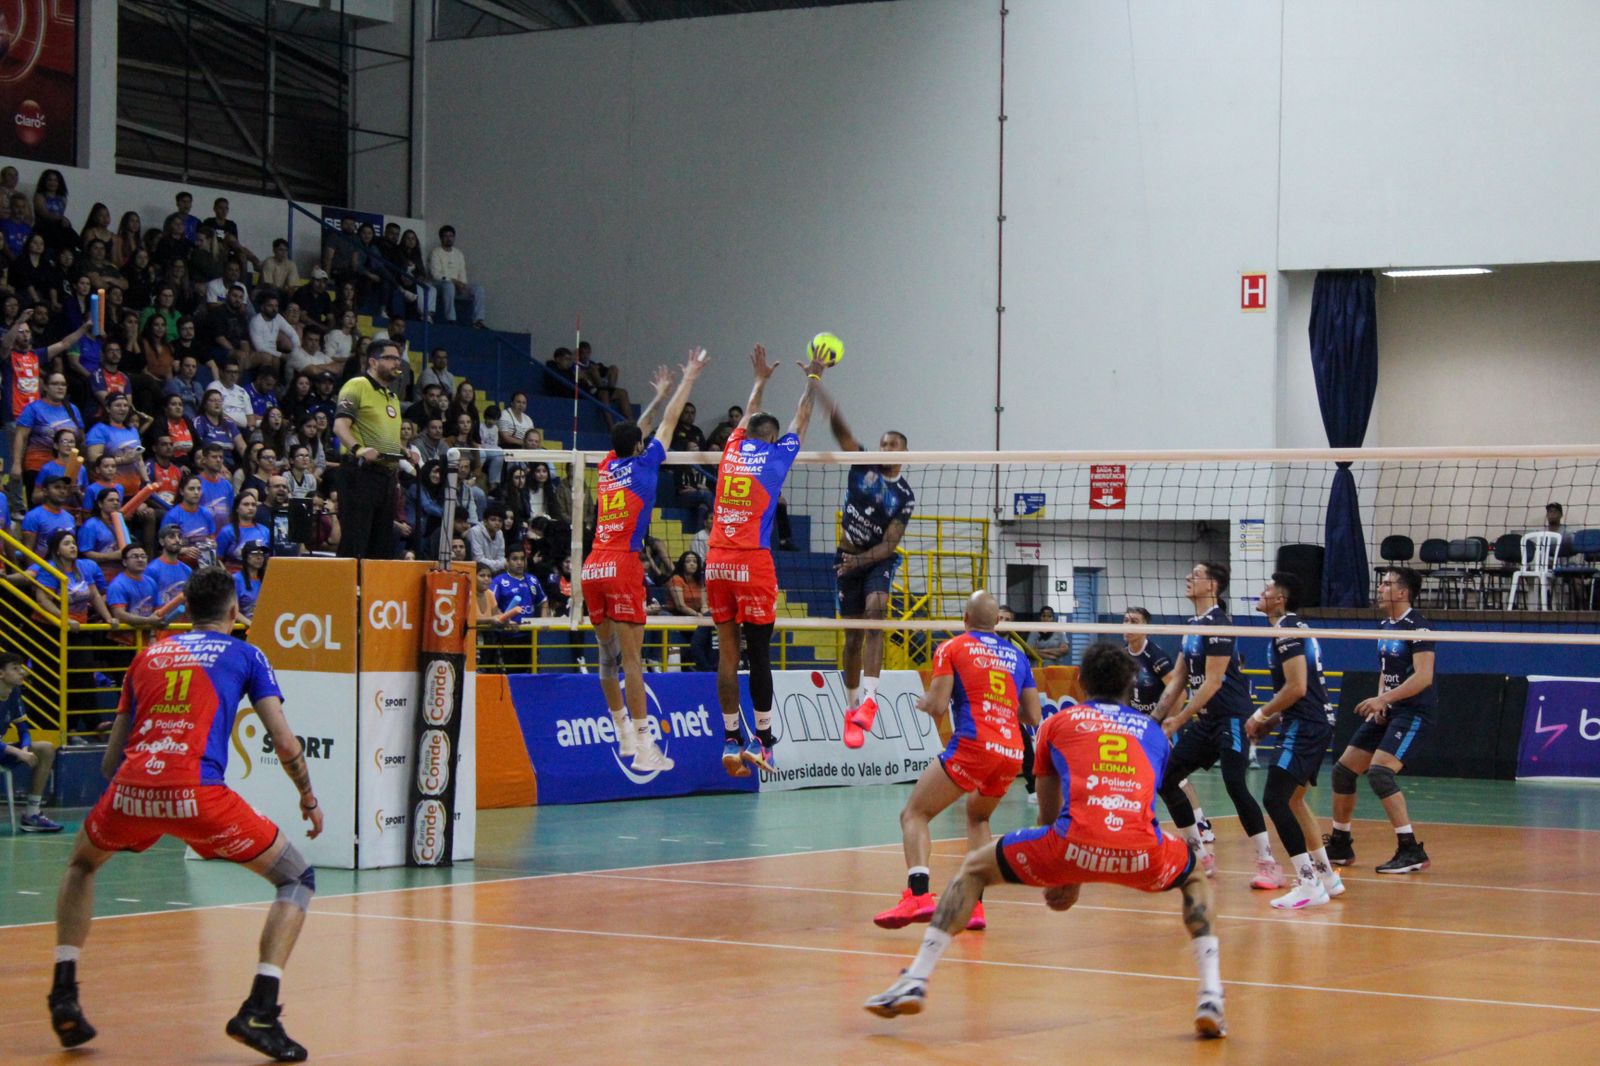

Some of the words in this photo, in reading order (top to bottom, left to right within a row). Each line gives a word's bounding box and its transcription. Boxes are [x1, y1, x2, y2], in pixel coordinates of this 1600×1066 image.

[15, 113, 41, 128] Claro
[1243, 278, 1264, 305] H
[726, 453, 766, 464] MILCLEAN
[722, 475, 751, 498] 13
[602, 490, 626, 513] 14
[369, 600, 413, 630] GOL
[433, 582, 458, 637] GOL
[274, 612, 341, 650] GOL
[146, 644, 226, 657] MILCLEAN
[174, 653, 218, 663] VINAC
[969, 647, 1018, 662] MILCLEAN
[164, 669, 193, 701] 11
[430, 665, 447, 721] Conde
[988, 670, 1006, 696] 5
[151, 704, 191, 714] FRANCK
[385, 698, 407, 707] SPORT
[1071, 711, 1148, 730] MILCLEAN
[262, 733, 334, 759] SRT
[1098, 733, 1128, 763] 2
[384, 755, 406, 765] SPORT
[422, 749, 430, 775] Farma
[425, 734, 441, 790] Conde
[759, 762, 838, 783] Universidade
[844, 762, 855, 777] do
[858, 762, 882, 777] Vale
[885, 760, 899, 775] do
[1092, 763, 1136, 774] LEONAM
[116, 784, 196, 800] DIAGNÓSTICOS
[1101, 776, 1142, 790] Poliedro
[385, 815, 405, 826] SPORT
[417, 819, 426, 846] Farma
[421, 804, 437, 861] Conde
